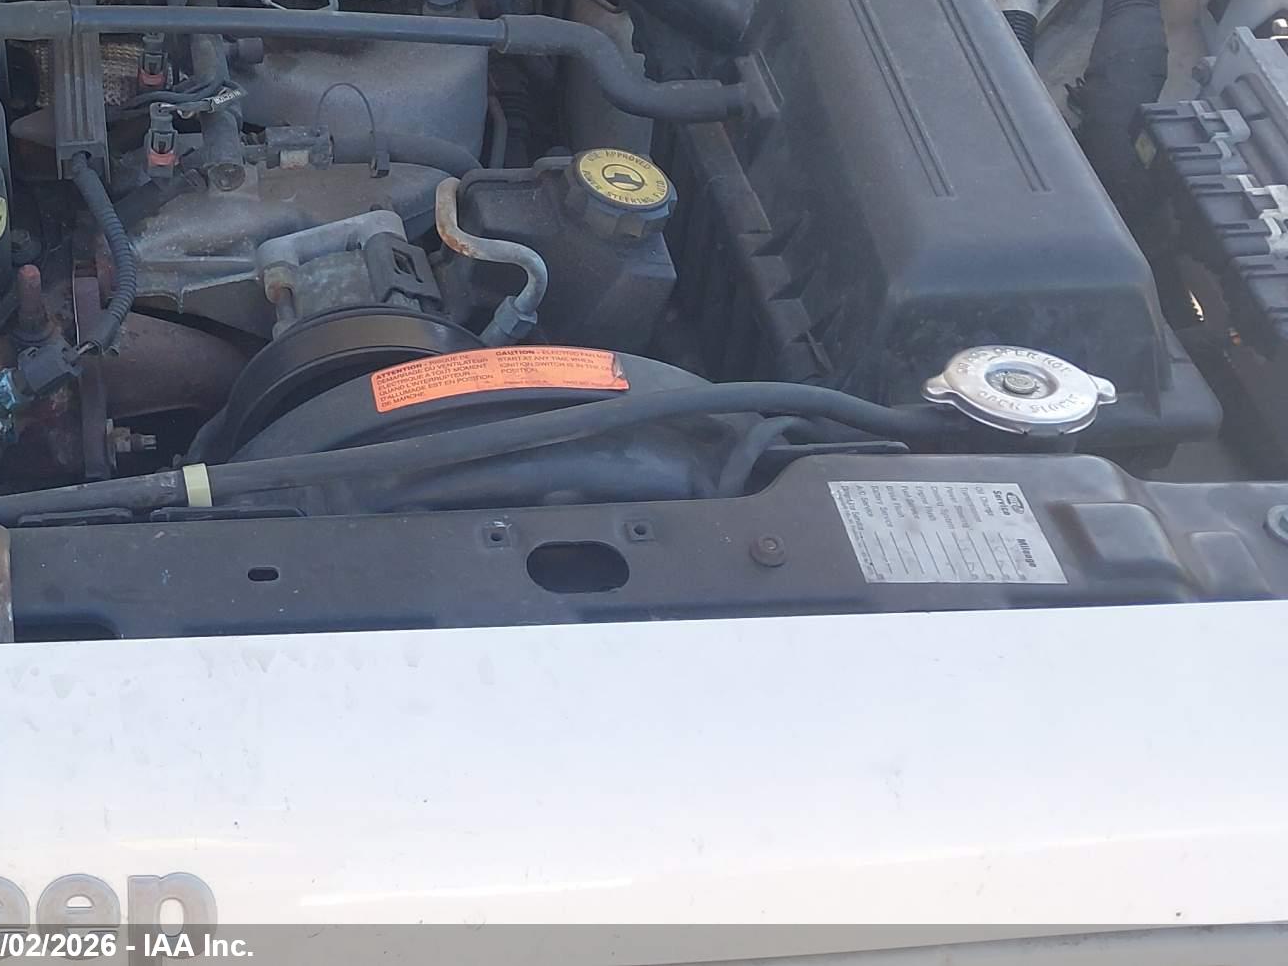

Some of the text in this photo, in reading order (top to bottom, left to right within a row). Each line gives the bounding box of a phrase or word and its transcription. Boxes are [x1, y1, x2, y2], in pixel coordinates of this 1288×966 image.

[376, 363, 422, 380] ATTENTION
[453, 364, 487, 372] MOMENT
[456, 374, 494, 383] POSITION
[379, 385, 405, 396] QUAND
[993, 490, 1011, 516] Service
[1015, 538, 1038, 568] Mileage
